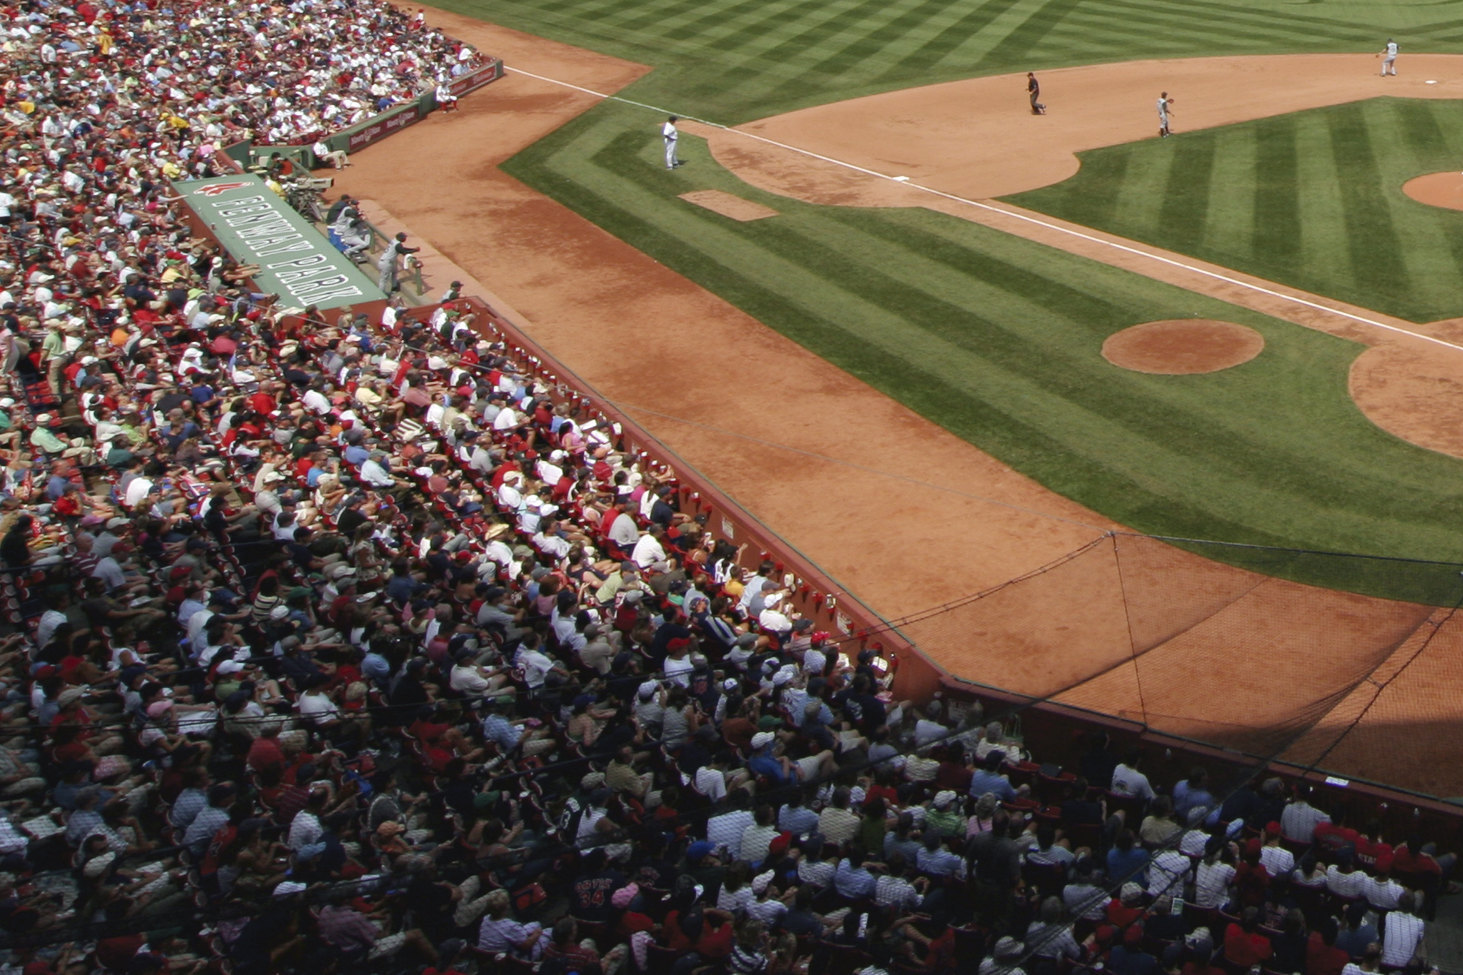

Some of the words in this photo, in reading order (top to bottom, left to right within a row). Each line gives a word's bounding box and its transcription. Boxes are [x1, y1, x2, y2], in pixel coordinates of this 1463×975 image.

[211, 195, 315, 257] FENWAY
[266, 253, 363, 307] PARK
[581, 889, 604, 908] 34
